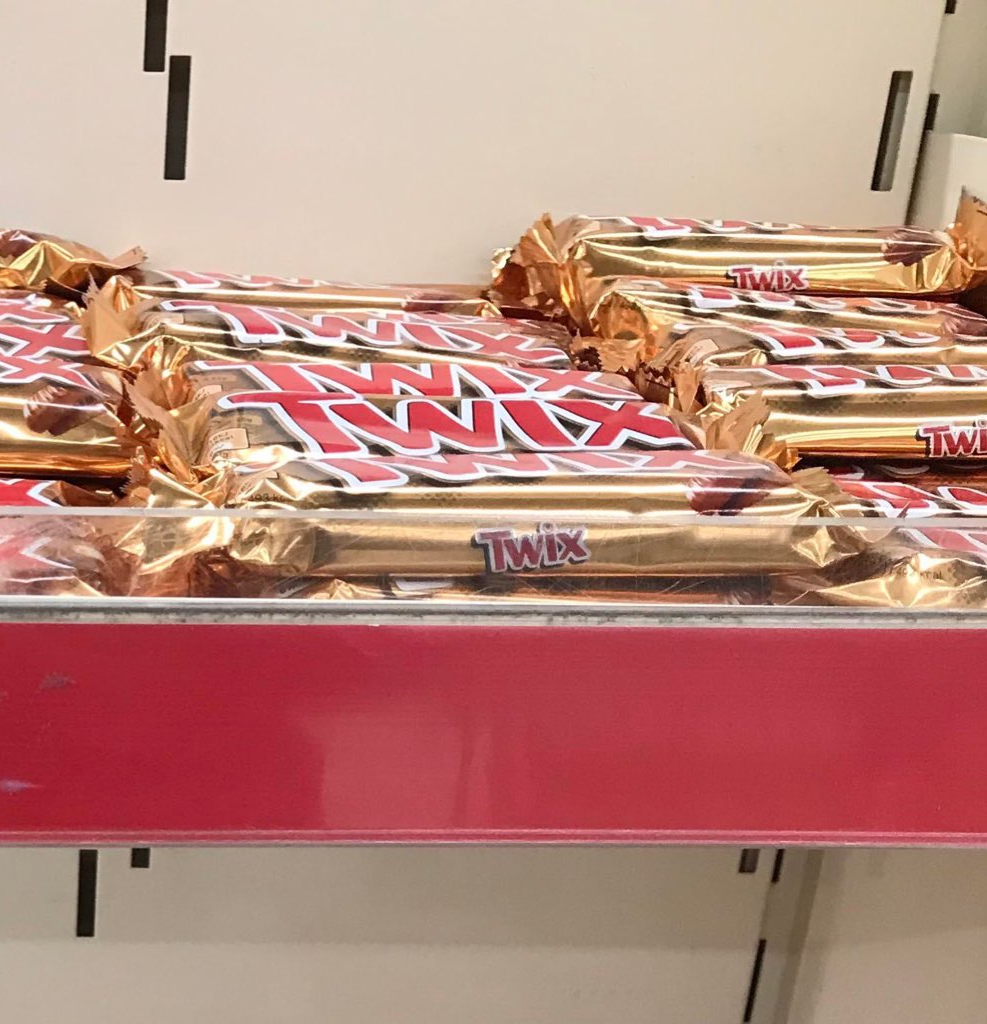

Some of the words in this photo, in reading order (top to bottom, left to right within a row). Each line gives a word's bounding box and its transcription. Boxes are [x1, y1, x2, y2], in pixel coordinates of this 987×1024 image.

[727, 260, 809, 291] Twix
[161, 299, 569, 363] Twix
[217, 390, 698, 460] Twix
[917, 420, 987, 458] Twi
[475, 521, 591, 574] Twix
